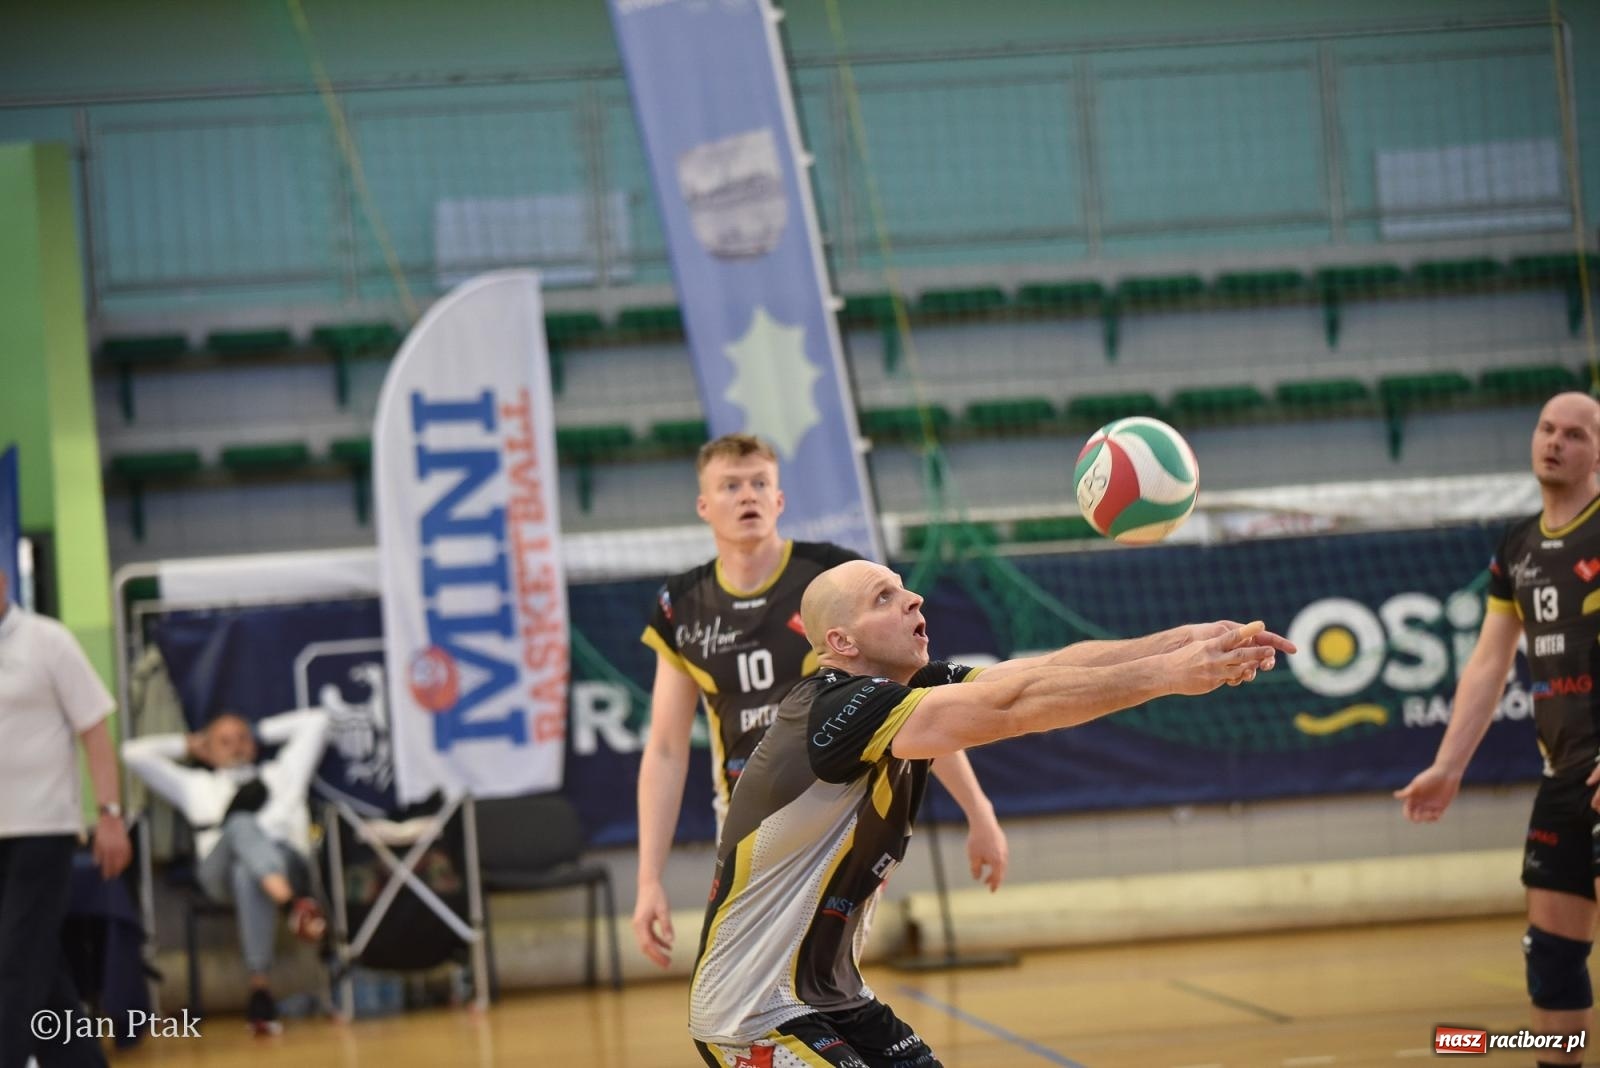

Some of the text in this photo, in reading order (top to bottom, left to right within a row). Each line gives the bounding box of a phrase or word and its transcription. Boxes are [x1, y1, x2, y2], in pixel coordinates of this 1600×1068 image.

[411, 387, 529, 752] MINI
[500, 387, 568, 745] BASKETBALL
[1533, 586, 1559, 623] 13
[737, 648, 775, 693] 10
[1286, 591, 1528, 698] OSi
[1534, 633, 1565, 657] ENTER
[812, 685, 875, 747] GTrans
